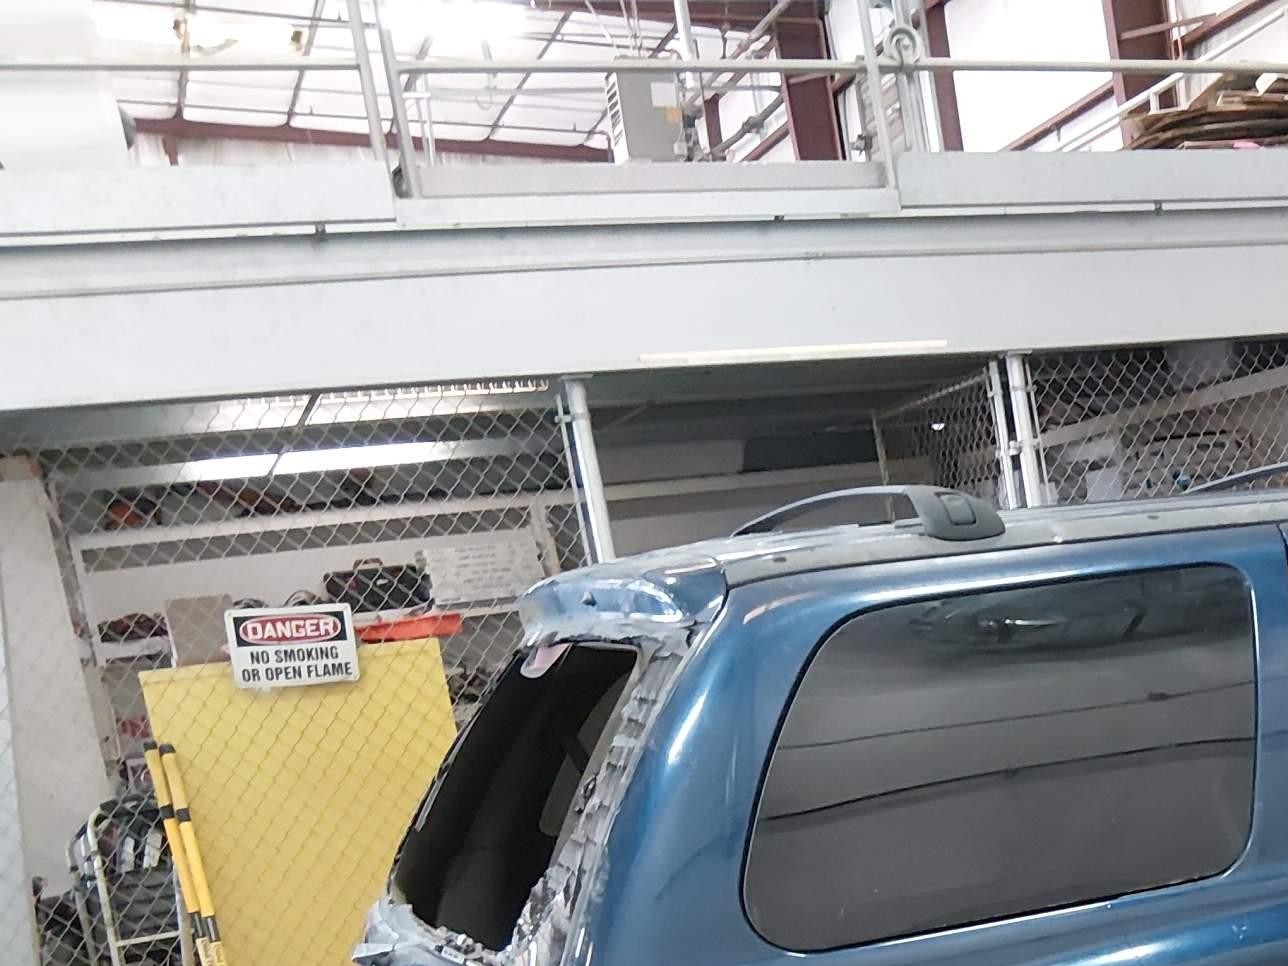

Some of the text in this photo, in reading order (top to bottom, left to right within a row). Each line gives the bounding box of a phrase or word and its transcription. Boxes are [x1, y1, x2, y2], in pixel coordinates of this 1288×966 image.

[247, 619, 335, 640] DANGER
[250, 645, 339, 665] NO SMOKING
[242, 662, 352, 683] OR OPEN FLAME
